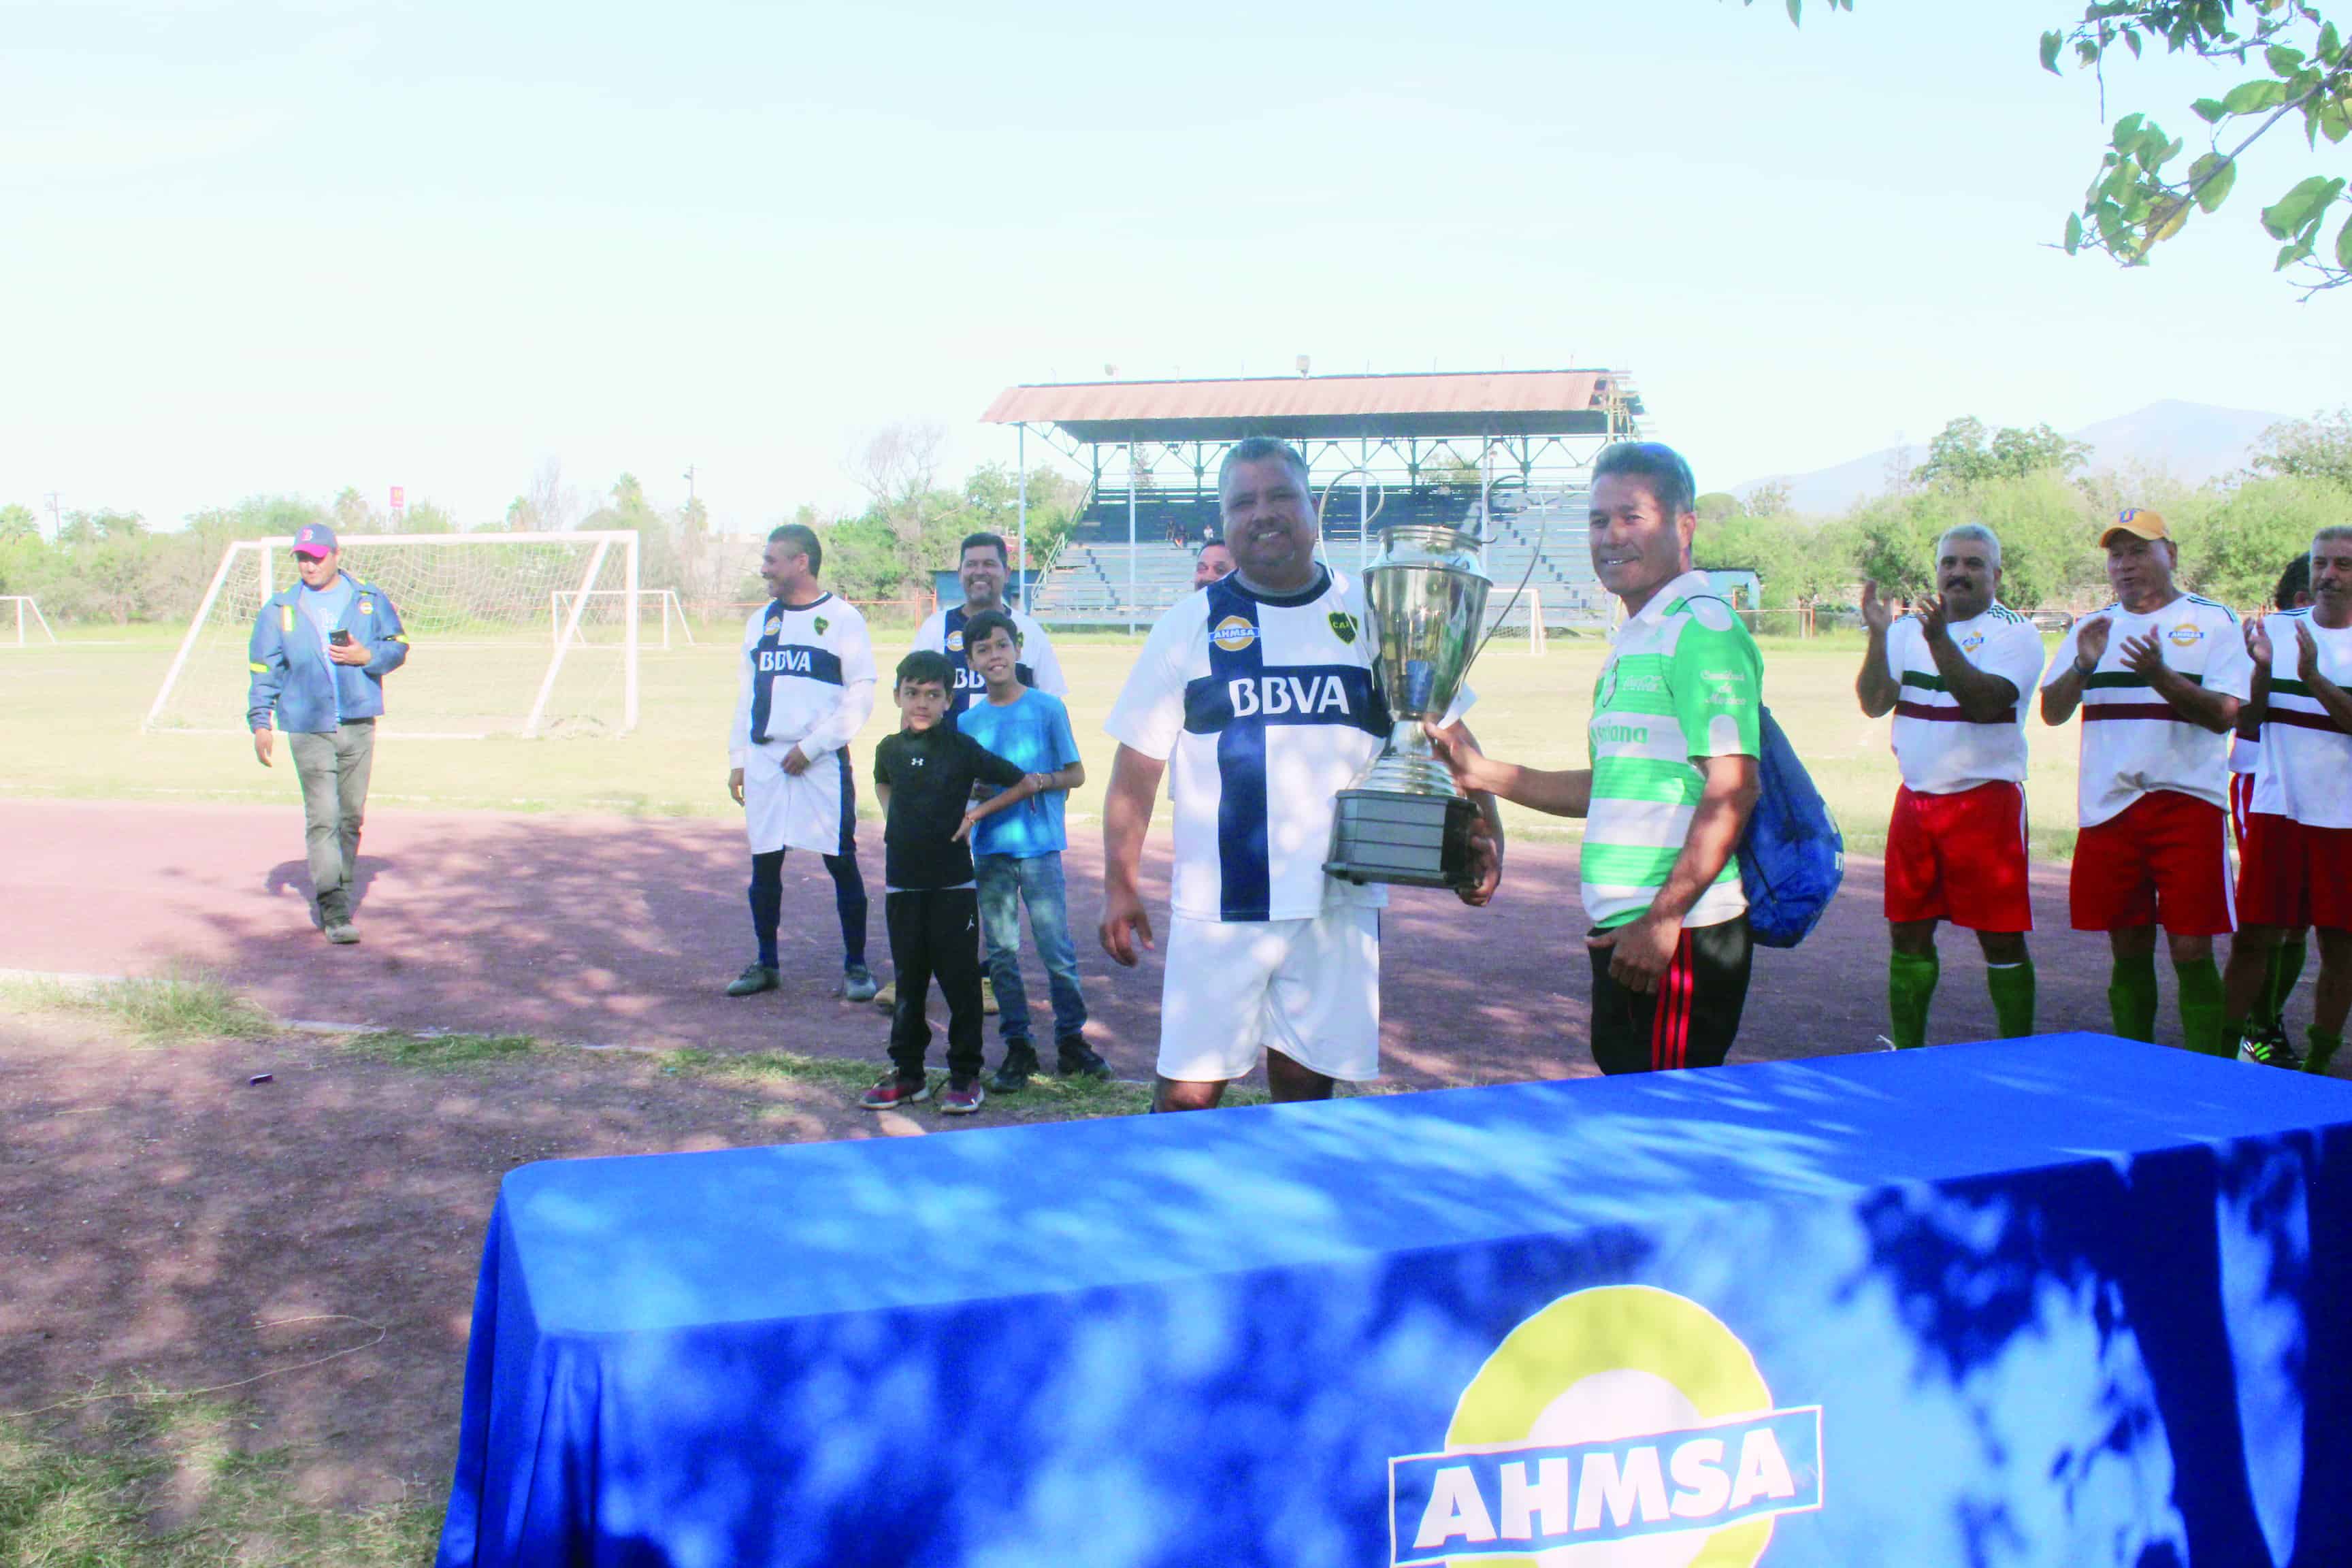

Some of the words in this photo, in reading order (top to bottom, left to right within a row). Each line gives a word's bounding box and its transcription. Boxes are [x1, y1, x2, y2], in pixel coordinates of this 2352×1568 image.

[1213, 627, 1255, 639] AHMSA
[760, 650, 811, 672] BBVA
[953, 668, 986, 689] BB
[1228, 676, 1350, 718] BBVA
[1412, 1427, 1795, 1548] AHMSA
